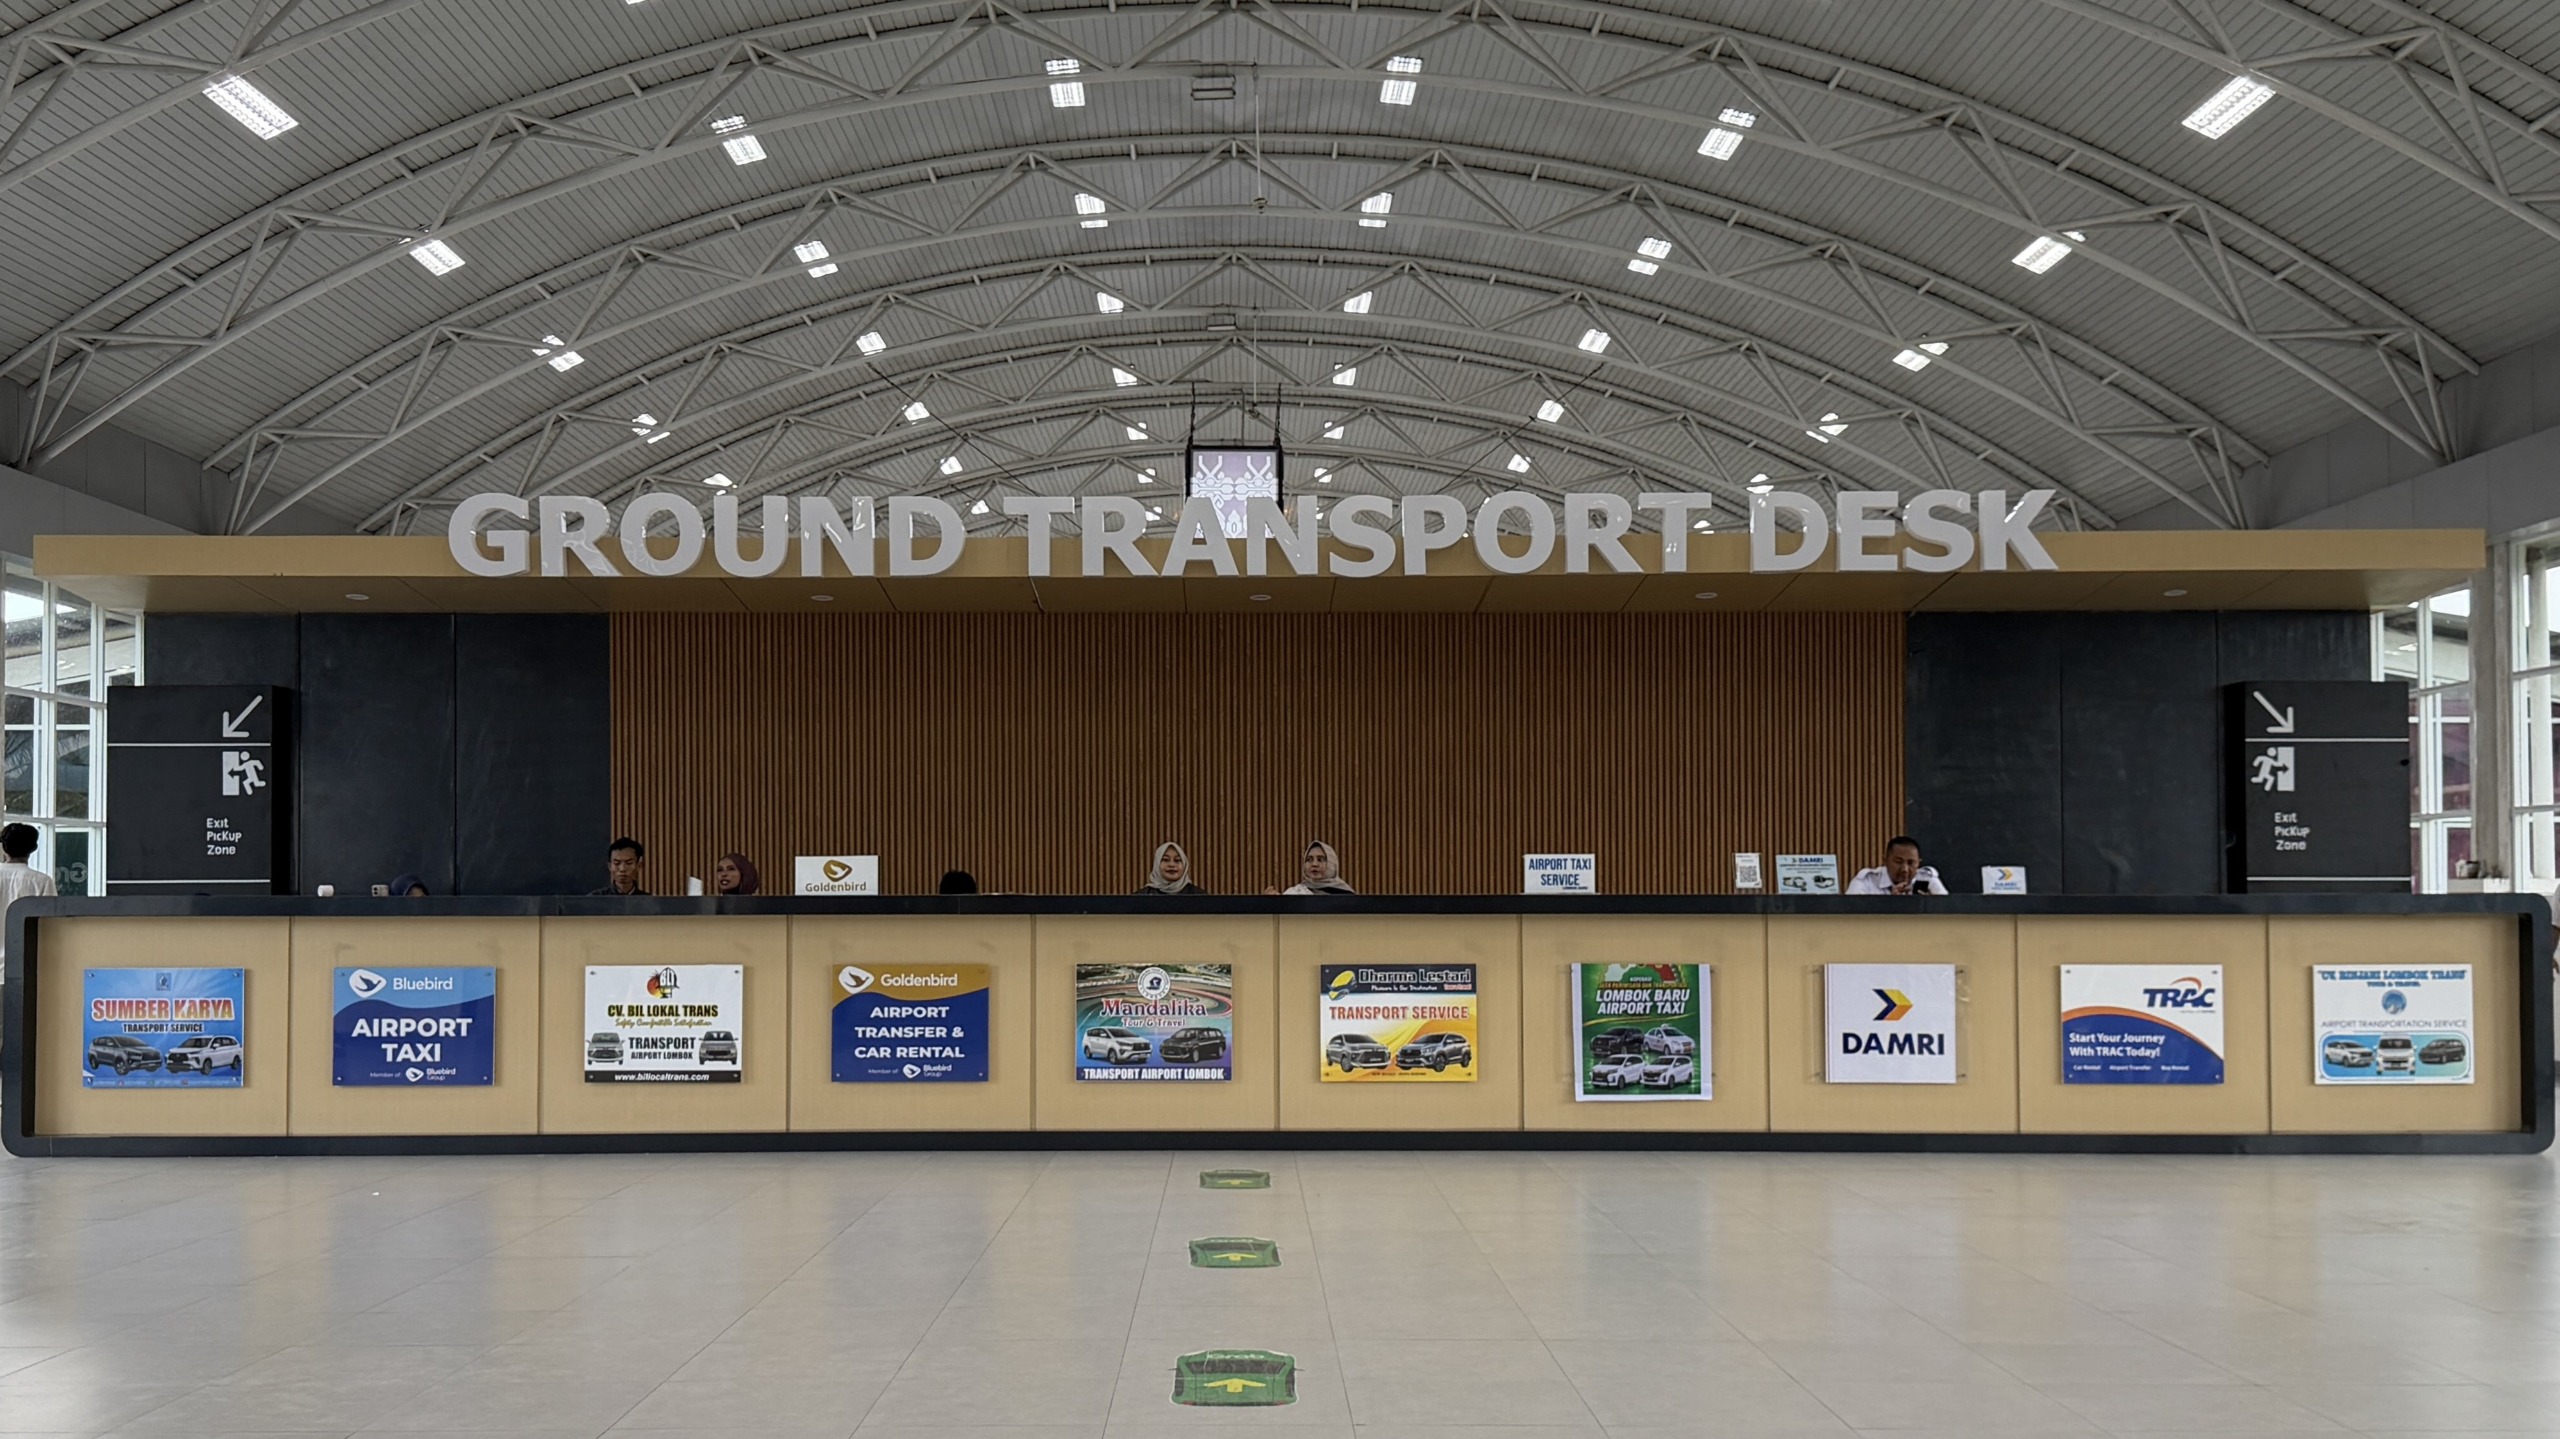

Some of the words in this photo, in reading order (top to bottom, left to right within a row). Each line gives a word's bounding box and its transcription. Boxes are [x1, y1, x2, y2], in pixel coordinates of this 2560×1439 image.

[448, 492, 966, 577] GROUND
[1003, 490, 1712, 578] TRANSPORT
[1749, 488, 2060, 573] DESK
[206, 818, 229, 829] Exit
[2274, 812, 2298, 823] Exit
[207, 845, 236, 855] Zone
[2276, 840, 2307, 851] Zone
[1528, 858, 1568, 870] AIRPORT
[1570, 858, 1592, 870] TAXI
[1541, 874, 1580, 886] SERVICE
[805, 882, 867, 892] Goldenbird
[880, 974, 958, 987] Goldenbird
[1359, 969, 1417, 983] Dharma
[1419, 969, 1471, 983] Lestari
[393, 977, 453, 990] Bluebird
[1596, 989, 1651, 1002] LOMBOK
[1654, 989, 1690, 1002] BARU
[2143, 988, 2216, 1007] TRAC
[92, 998, 170, 1021] SUMBER
[173, 998, 235, 1021] KARYA
[607, 1004, 625, 1017] CV.
[627, 1004, 645, 1017] BIL
[647, 1004, 681, 1017] LOKAL
[682, 1004, 719, 1017] TRANS
[870, 1006, 950, 1018] AIRPORT
[1101, 998, 1207, 1016] Mandalika
[1329, 1006, 1408, 1020] TRANSPORT
[1412, 1006, 1468, 1019] SERVICE
[1597, 1002, 1653, 1015] AIRPORT
[1656, 1002, 1686, 1014] TAXI
[351, 1018, 473, 1037] AIRPORT
[1123, 1017, 1143, 1026] Tour
[1157, 1017, 1186, 1026] Travel
[2321, 1019, 2356, 1028] AIRPORT
[2358, 1019, 2432, 1028] TRANSPORTATION
[2433, 1019, 2467, 1028] SERVICE
[123, 1023, 169, 1033] TRANSPORT
[171, 1023, 203, 1032] SERVICE
[854, 1026, 947, 1038] TRANSFER
[951, 1026, 964, 1038] &
[628, 1037, 696, 1049] TRANSPORT
[1842, 1032, 1945, 1055] DAMRI
[2069, 1033, 2095, 1043] Start
[2097, 1033, 2121, 1043] Your
[2122, 1033, 2165, 1045] Journey
[381, 1043, 441, 1062] TAXI
[631, 1051, 662, 1060] AIRPORT
[663, 1051, 693, 1060] LOMBOK
[854, 1046, 891, 1058] CAR
[896, 1046, 965, 1058] RENTAL
[2069, 1046, 2094, 1057] With
[2096, 1046, 2124, 1057] TRAC
[2125, 1046, 2160, 1059] Today!
[426, 1067, 456, 1075] Bluebird
[1083, 1068, 1140, 1080] TRANSPORT
[1141, 1068, 1182, 1080] AIRPORT
[1184, 1068, 1224, 1079] LOMBOK
